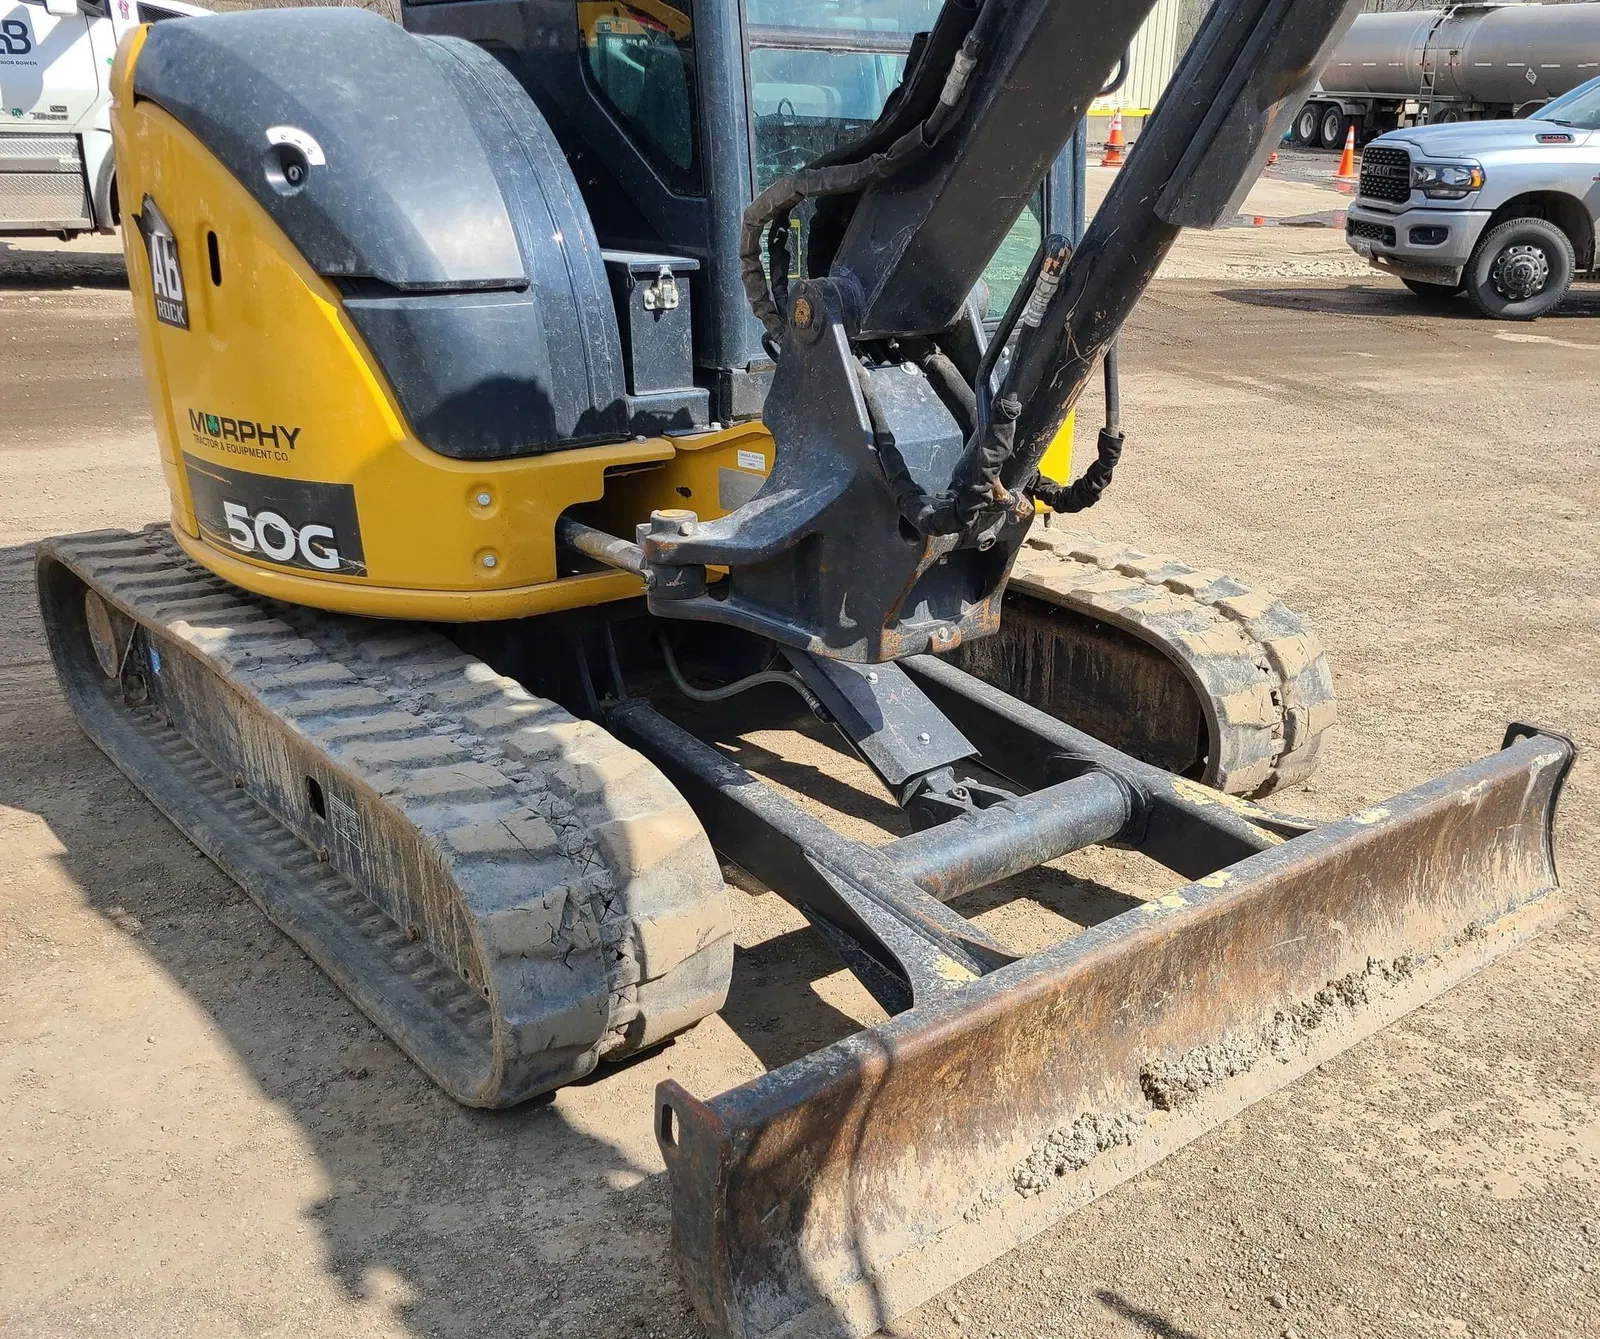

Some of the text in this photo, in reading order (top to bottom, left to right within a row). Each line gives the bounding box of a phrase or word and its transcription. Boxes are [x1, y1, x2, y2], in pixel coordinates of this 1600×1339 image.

[1368, 164, 1393, 177] RAM
[157, 299, 186, 325] ROCK
[188, 408, 302, 450] MURPHY
[193, 433, 292, 462] TRACTOR & EQUIPMENT CO.
[223, 500, 341, 570] 50G
